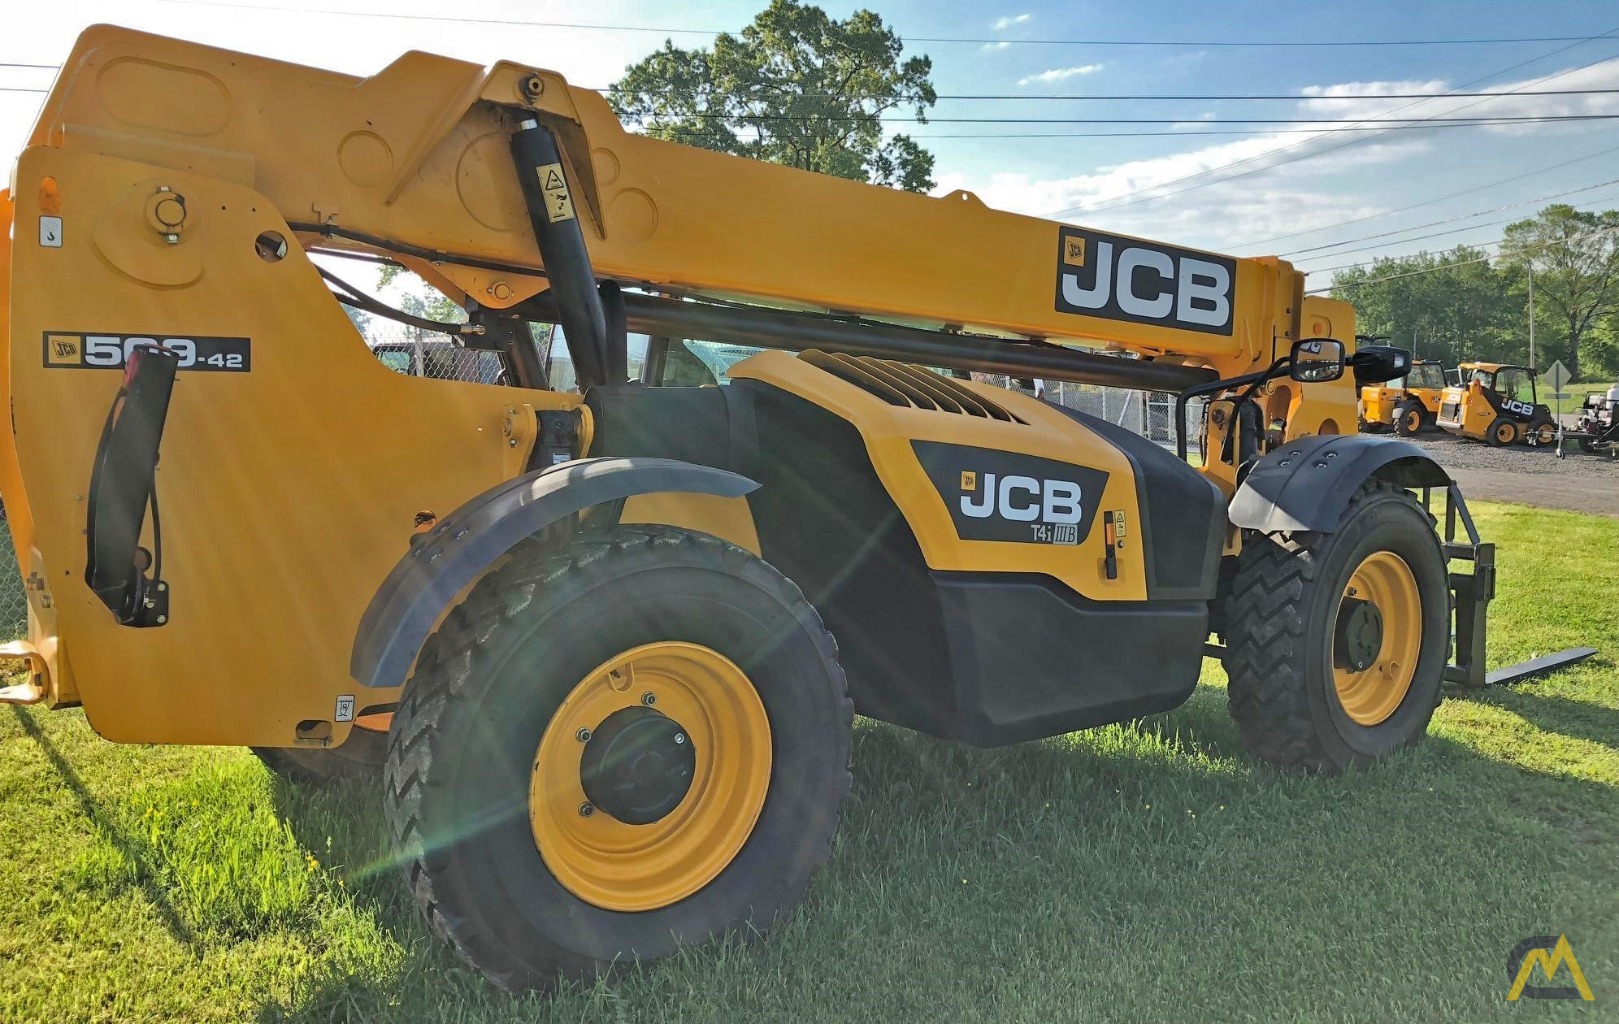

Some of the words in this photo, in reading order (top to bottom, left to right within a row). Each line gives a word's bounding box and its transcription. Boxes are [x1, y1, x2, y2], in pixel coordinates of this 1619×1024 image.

[1062, 241, 1230, 327] JCB
[57, 342, 76, 356] JCB
[1501, 399, 1534, 416] JCB
[960, 473, 1082, 524] JCB
[1031, 524, 1052, 542] T4i
